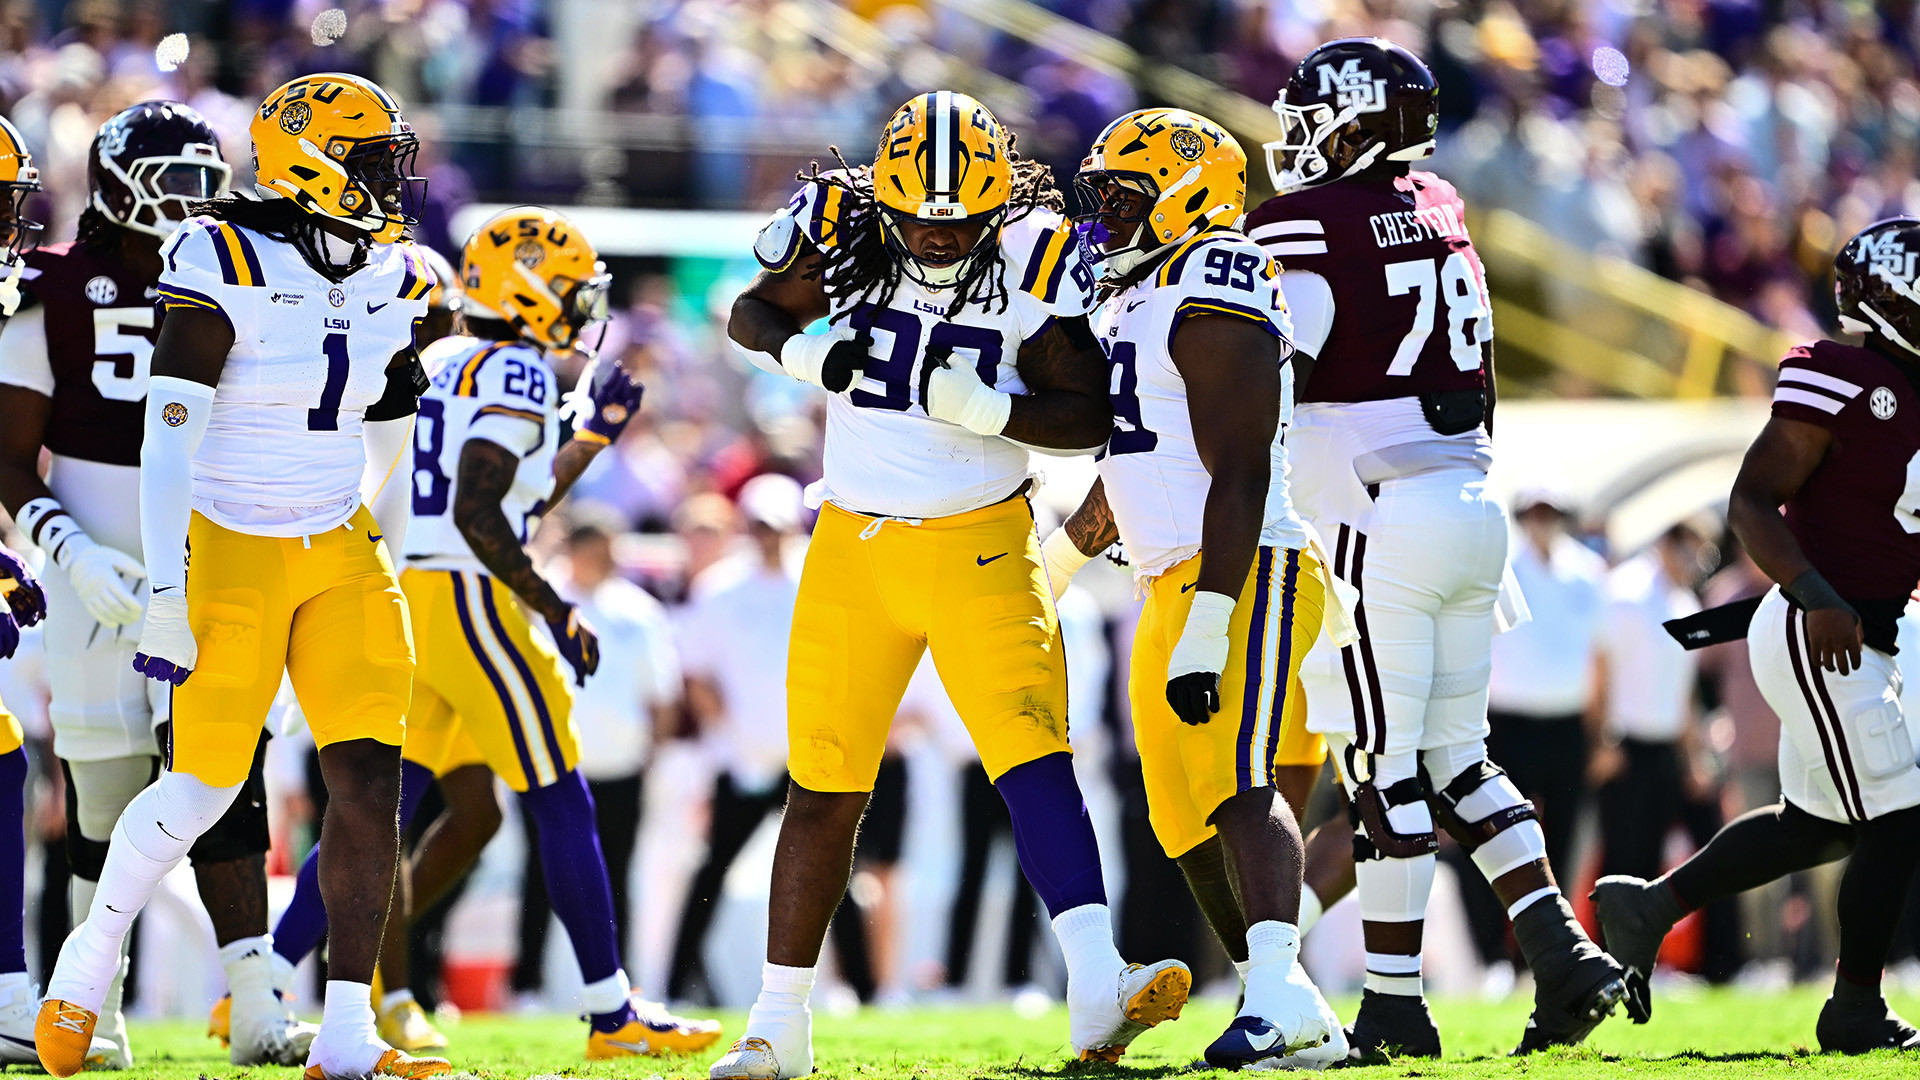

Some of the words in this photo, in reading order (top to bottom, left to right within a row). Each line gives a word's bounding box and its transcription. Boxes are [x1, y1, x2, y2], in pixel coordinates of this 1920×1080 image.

[1316, 58, 1388, 114] MSU
[889, 111, 916, 160] SU
[971, 112, 996, 163] LS
[489, 218, 568, 248] LSU
[929, 208, 954, 216] LSU
[1204, 247, 1261, 293] 99
[1854, 230, 1920, 284] MSU
[324, 317, 351, 330] LSU
[913, 299, 945, 316] LSU
[1384, 252, 1488, 376] 78
[307, 333, 350, 431] 1
[504, 359, 547, 405] 28
[1100, 338, 1158, 457] 9
